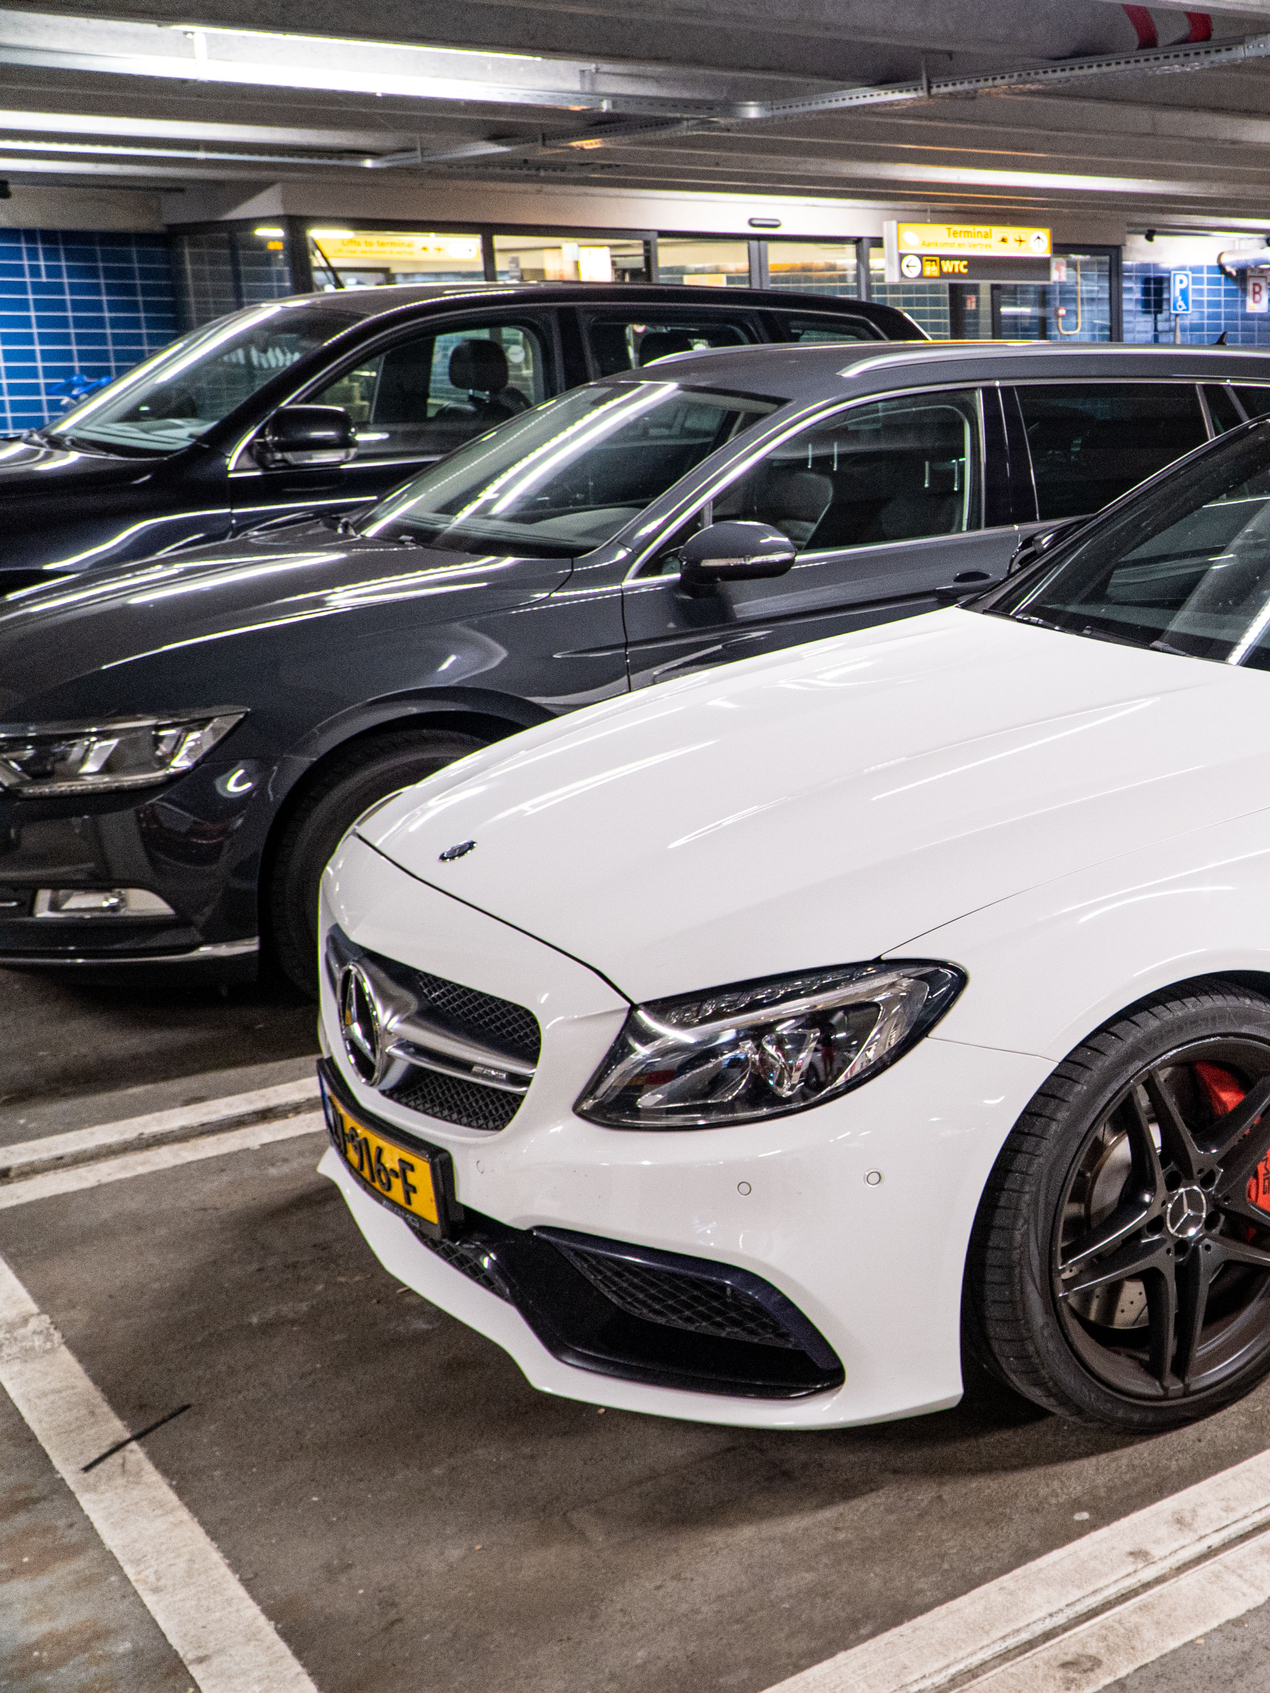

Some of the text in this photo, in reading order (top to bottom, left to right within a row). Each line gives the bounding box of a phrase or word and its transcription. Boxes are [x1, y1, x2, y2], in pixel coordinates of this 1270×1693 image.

[946, 227, 992, 239] Terminal
[364, 239, 374, 247] to
[921, 240, 955, 248] Aankomst
[941, 260, 968, 273] WTC
[1174, 274, 1188, 297] P
[1252, 282, 1262, 304] B
[1262, 1156, 1270, 1195] MG
